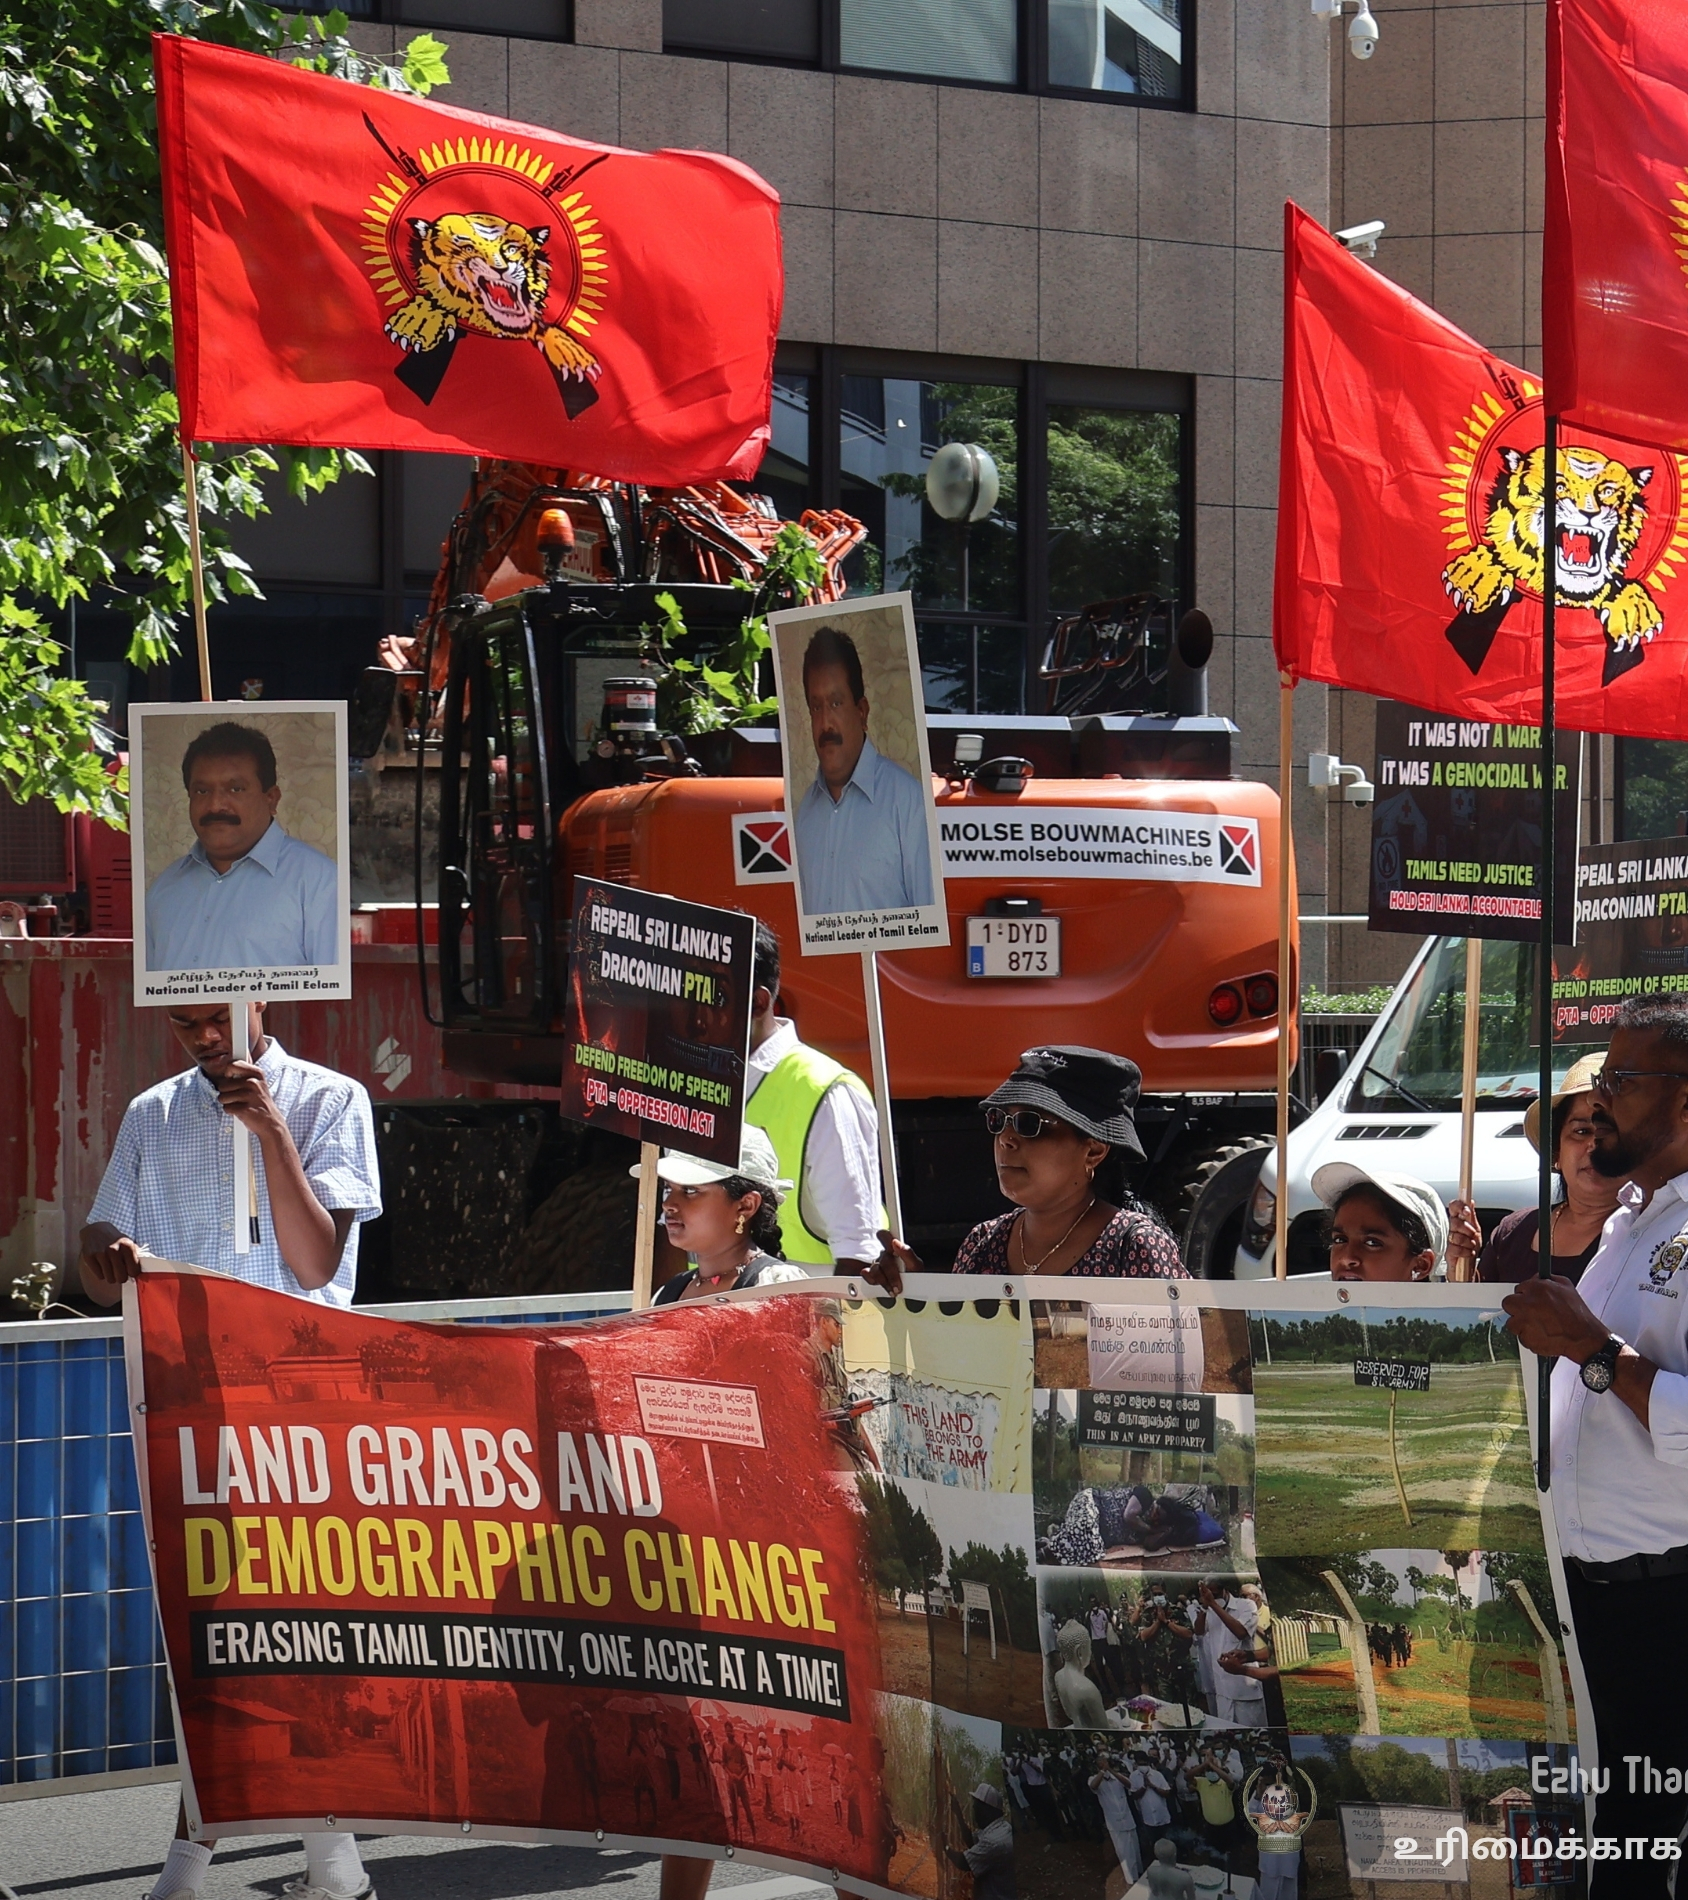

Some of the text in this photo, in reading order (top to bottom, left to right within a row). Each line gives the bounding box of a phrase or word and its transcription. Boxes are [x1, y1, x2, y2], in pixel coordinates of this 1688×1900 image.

[1409, 723, 1505, 747] IT WAS NOT A
[1382, 761, 1529, 788] IT WAS A GENOCIDAL
[941, 823, 1212, 848] MOLSE BOUWMACHINES
[946, 845, 1213, 868] www.molsebouwmachines.be
[1406, 860, 1534, 886] TAMILS NEED JUSTICE.
[1618, 860, 1642, 884] SRI
[1390, 890, 1470, 913] HOLD SRI LANKA
[591, 904, 732, 964] REPEAL SRI LANKA'S
[806, 924, 938, 943] National Leader of Tamil Eelam
[973, 963, 981, 972] B
[1009, 951, 1047, 971] 873
[146, 980, 339, 995] National Leader of Tamil Eelam
[601, 950, 715, 1005] DRACONIAN PTA!
[1589, 975, 1641, 997] FREEDOM
[1643, 975, 1659, 993] OF
[1557, 1006, 1579, 1026] PTA
[575, 1043, 731, 1107] DEFEND FREEDOM OF SPEECH!
[586, 1078, 715, 1138] PTA OPPRESSION ACT!
[1356, 1360, 1428, 1380] RESERVED FOR
[1389, 1378, 1415, 1389] ARMY
[903, 1401, 973, 1433] THIS LAND
[966, 1435, 983, 1448] TO
[1087, 1429, 1106, 1440] THIS
[1110, 1431, 1119, 1441] IS
[1122, 1432, 1134, 1443] AN
[1138, 1433, 1161, 1444] ARMY
[178, 1426, 661, 1517] LAND GRABS AND
[926, 1443, 987, 1479] THE ARMY
[184, 1516, 836, 1633] DEMOGRAPHIC CHANGE
[207, 1620, 842, 1708] ERASING TAMIL IDENTITY, ONE ACRE AT A TIME!
